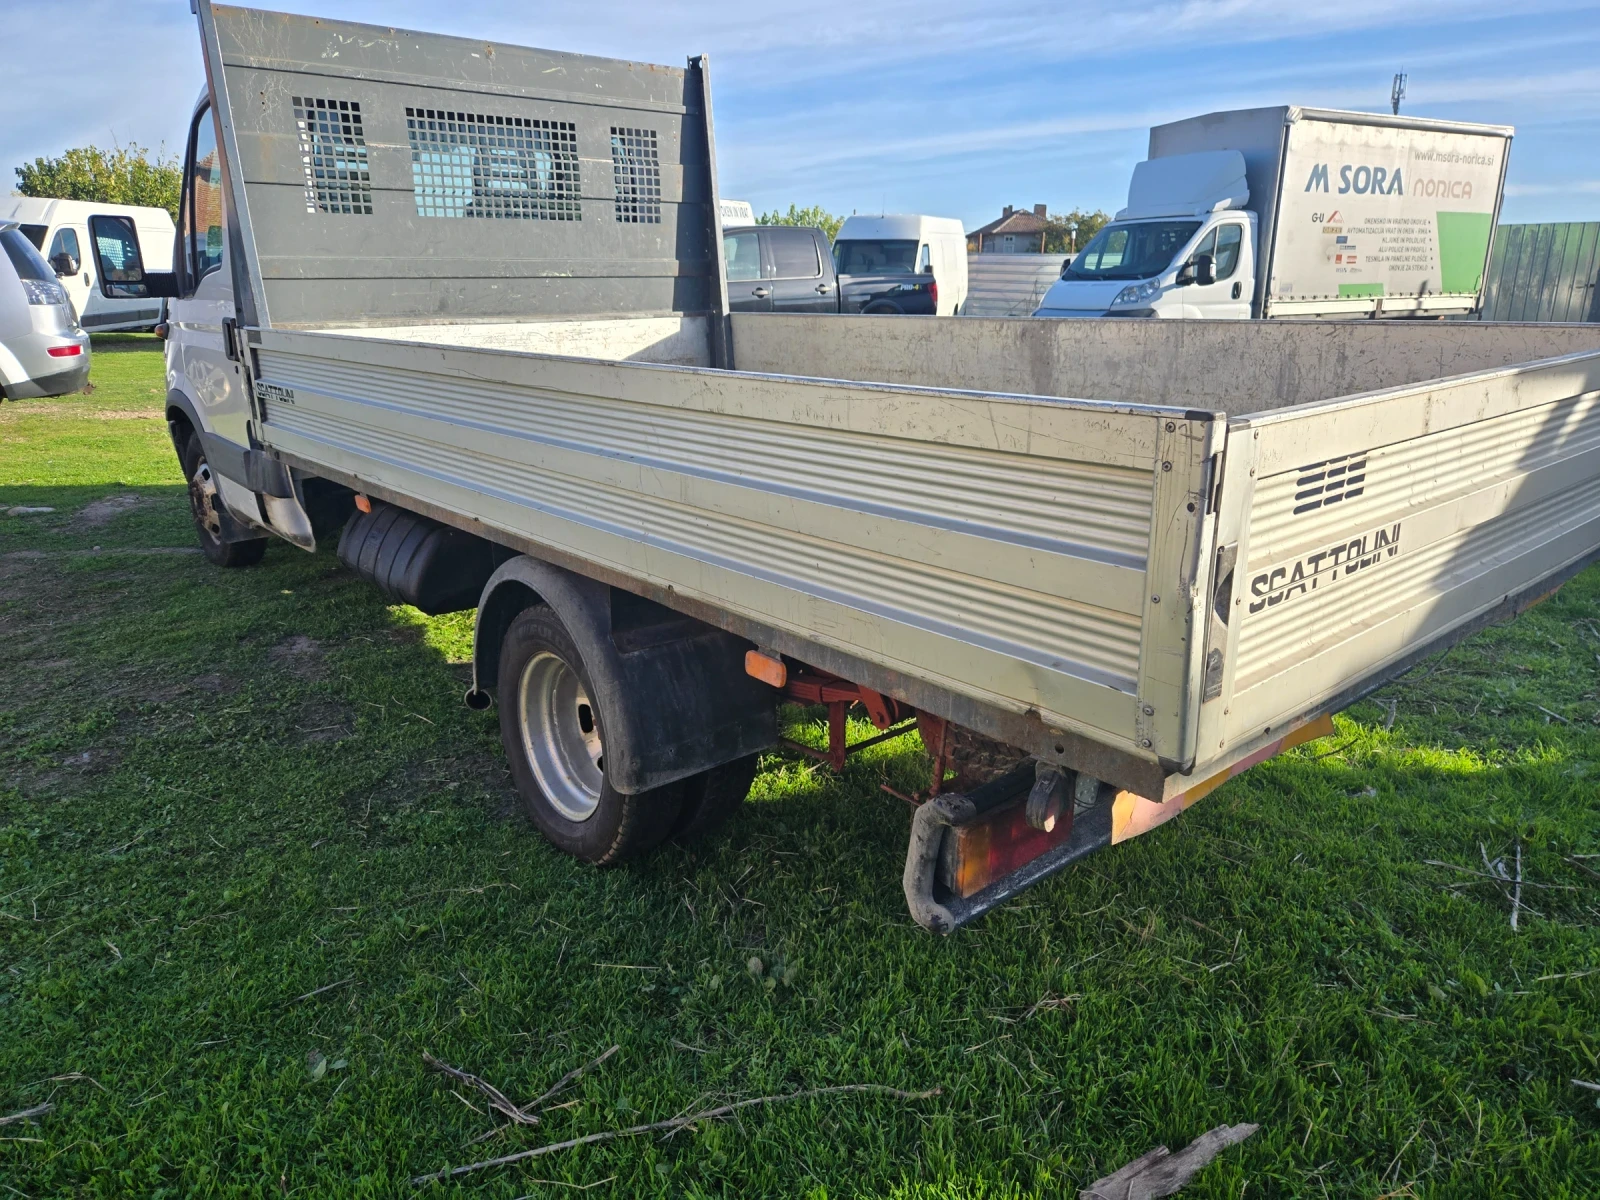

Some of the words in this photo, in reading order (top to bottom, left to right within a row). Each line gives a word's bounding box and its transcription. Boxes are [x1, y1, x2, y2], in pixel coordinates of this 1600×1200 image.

[1414, 150, 1495, 166] www.msora-norica.si
[1304, 163, 1330, 193] M
[1338, 164, 1404, 196] SORA
[256, 382, 295, 405] SCATTOLINI
[1249, 522, 1402, 615] SCATTOLINI
